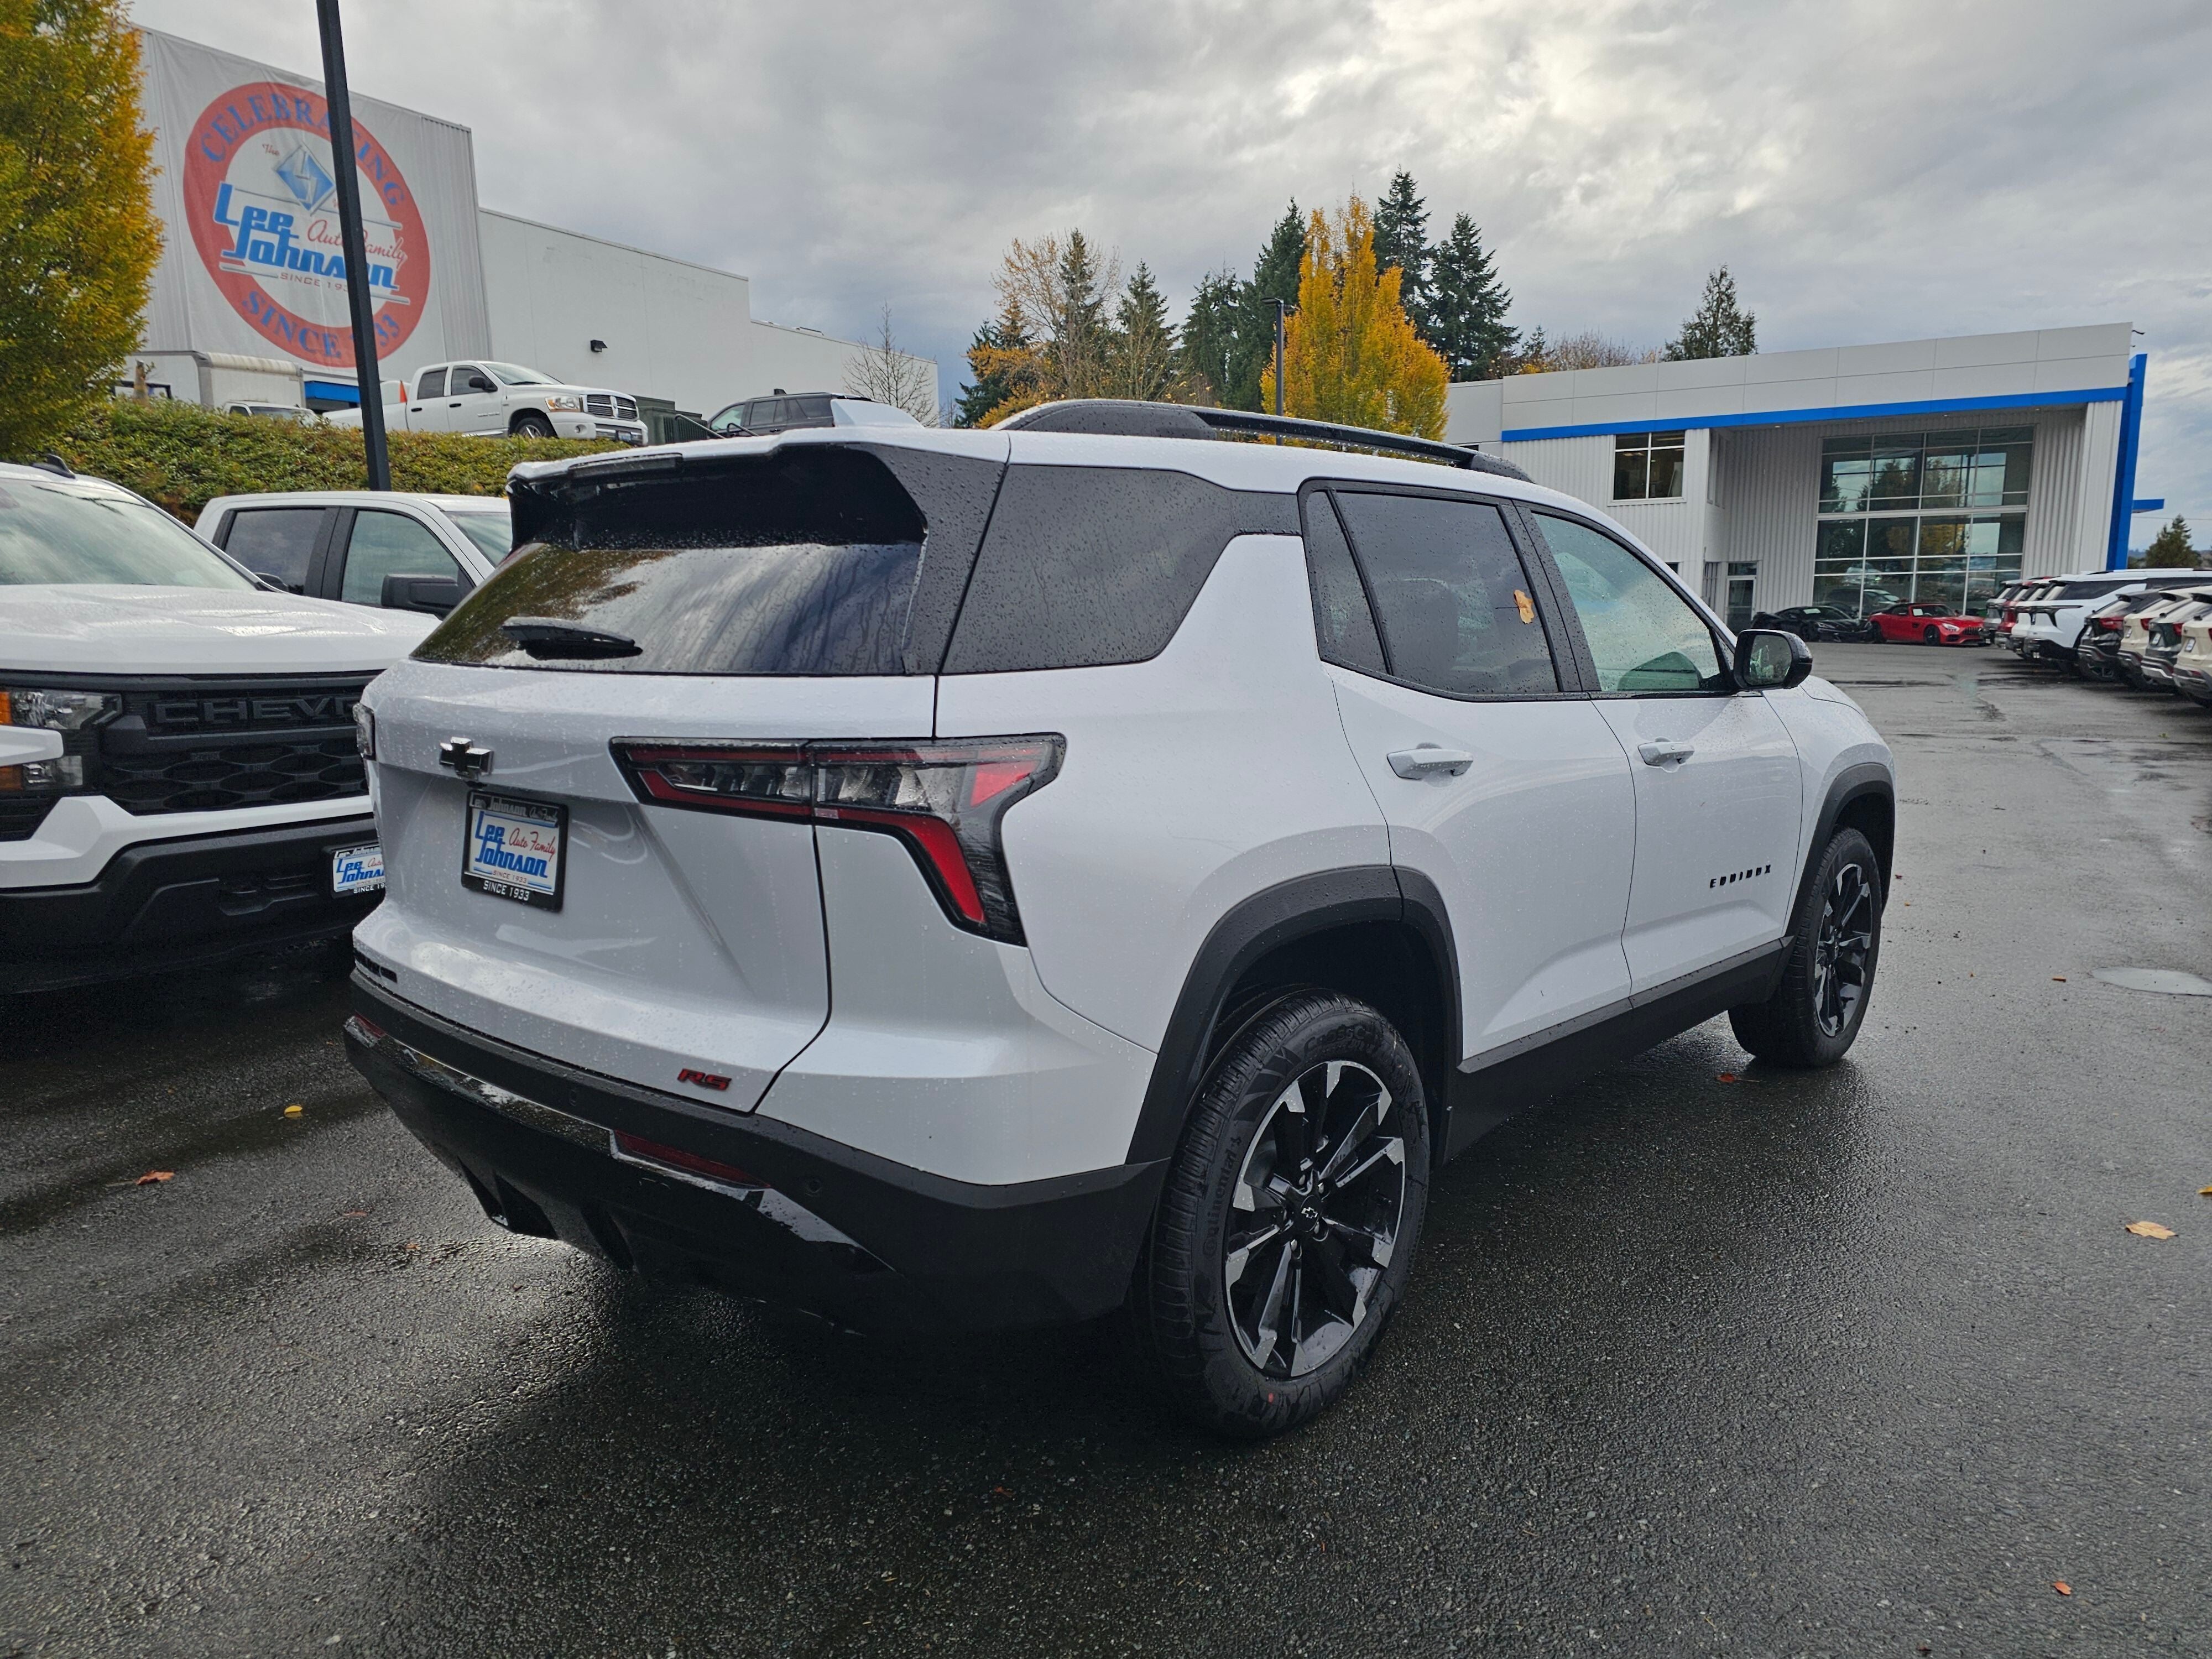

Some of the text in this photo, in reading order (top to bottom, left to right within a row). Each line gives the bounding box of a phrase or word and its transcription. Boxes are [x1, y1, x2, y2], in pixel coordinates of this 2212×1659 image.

[214, 183, 296, 237] Lee
[307, 220, 345, 247] Aut
[222, 228, 399, 290] Johnsn
[280, 272, 320, 286] SINCE
[242, 291, 341, 358] SINCE
[474, 811, 505, 844] Lee
[509, 827, 556, 861] Auto Family
[336, 859, 363, 873] Lee
[474, 839, 548, 878] Johnson
[353, 885, 374, 894] SINCE
[483, 880, 530, 901] SINCE 1933
[492, 870, 528, 884] SINCE 1933
[677, 1068, 732, 1091] RS
